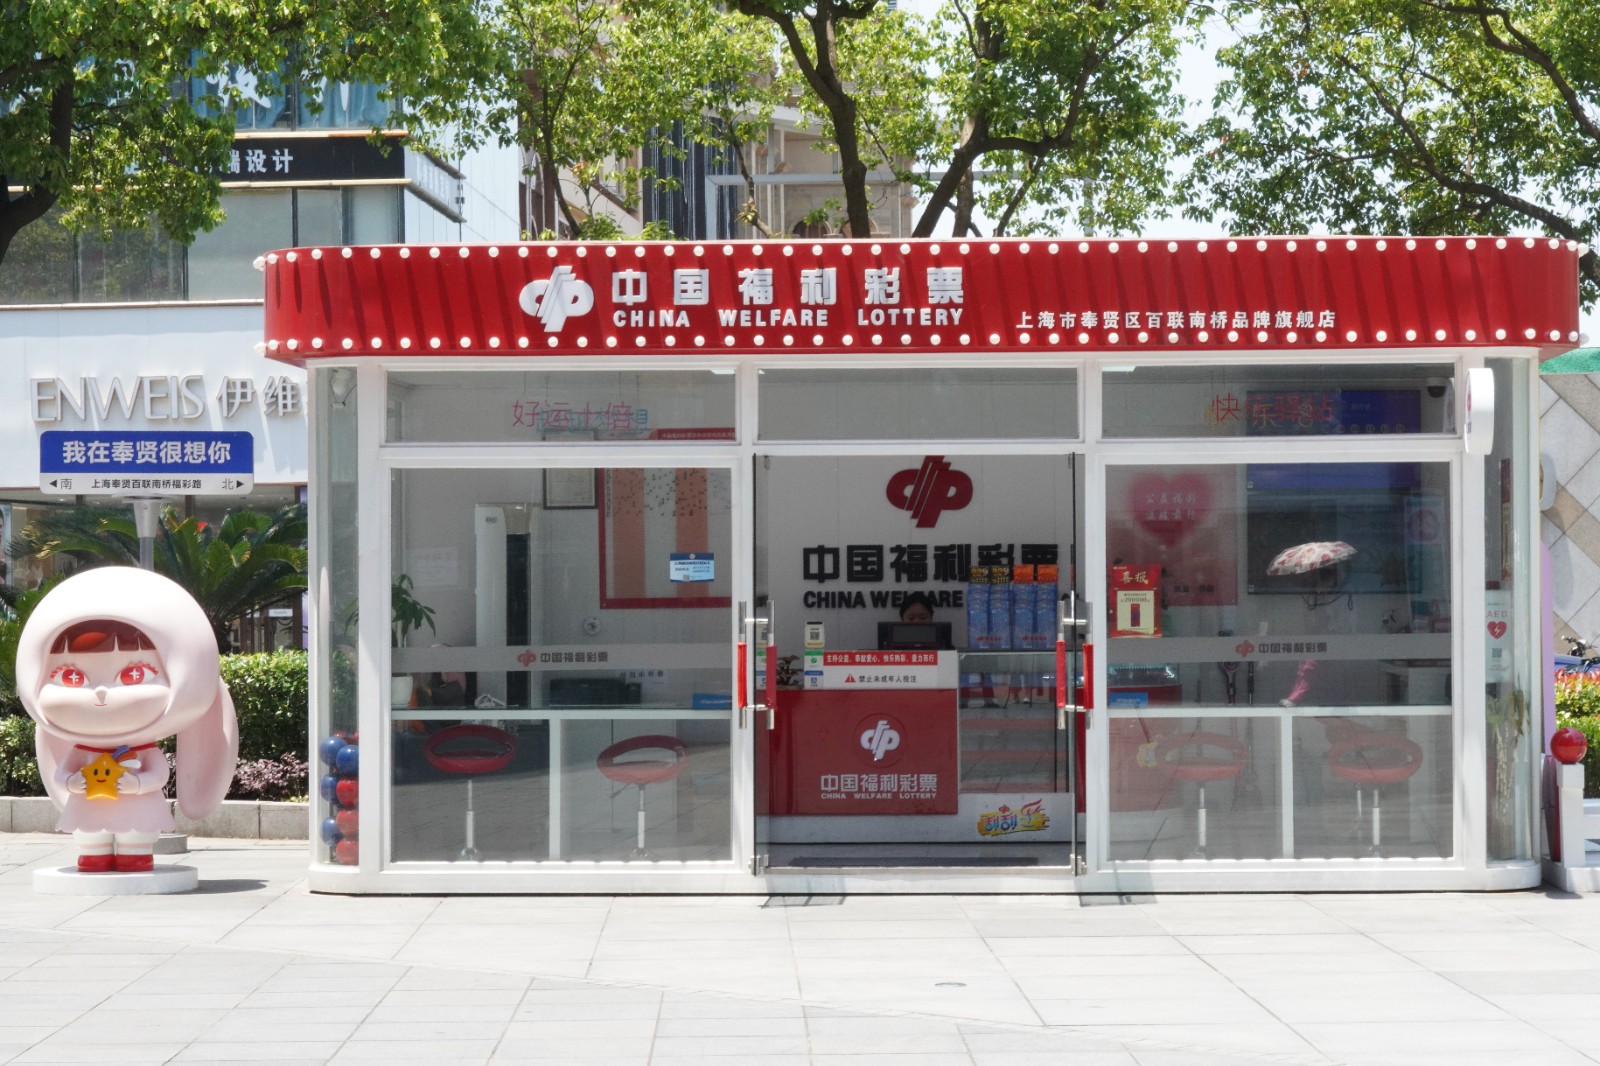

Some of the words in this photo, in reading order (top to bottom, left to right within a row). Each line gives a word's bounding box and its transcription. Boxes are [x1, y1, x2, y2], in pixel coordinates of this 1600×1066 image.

[612, 267, 964, 305] 中国福利彩票
[613, 310, 690, 327] CHINA
[719, 308, 828, 327] WELFARE
[858, 308, 963, 326] LOTTERY
[1016, 310, 1336, 330] 上海市奉贤区百联南桥品牌旗舰店
[31, 375, 204, 421] ENWEIS
[512, 400, 634, 431] 好运十倍
[62, 440, 231, 464] 我在奉贤很想你
[60, 478, 73, 490] 南
[91, 478, 202, 490] 上海奉贤百联南桥福彩路
[222, 478, 235, 490] 北
[803, 590, 866, 608] CHINA
[1486, 610, 1508, 618] AED
[540, 651, 609, 663] 中国福利彩票
[821, 773, 937, 792] 中国福利彩票
